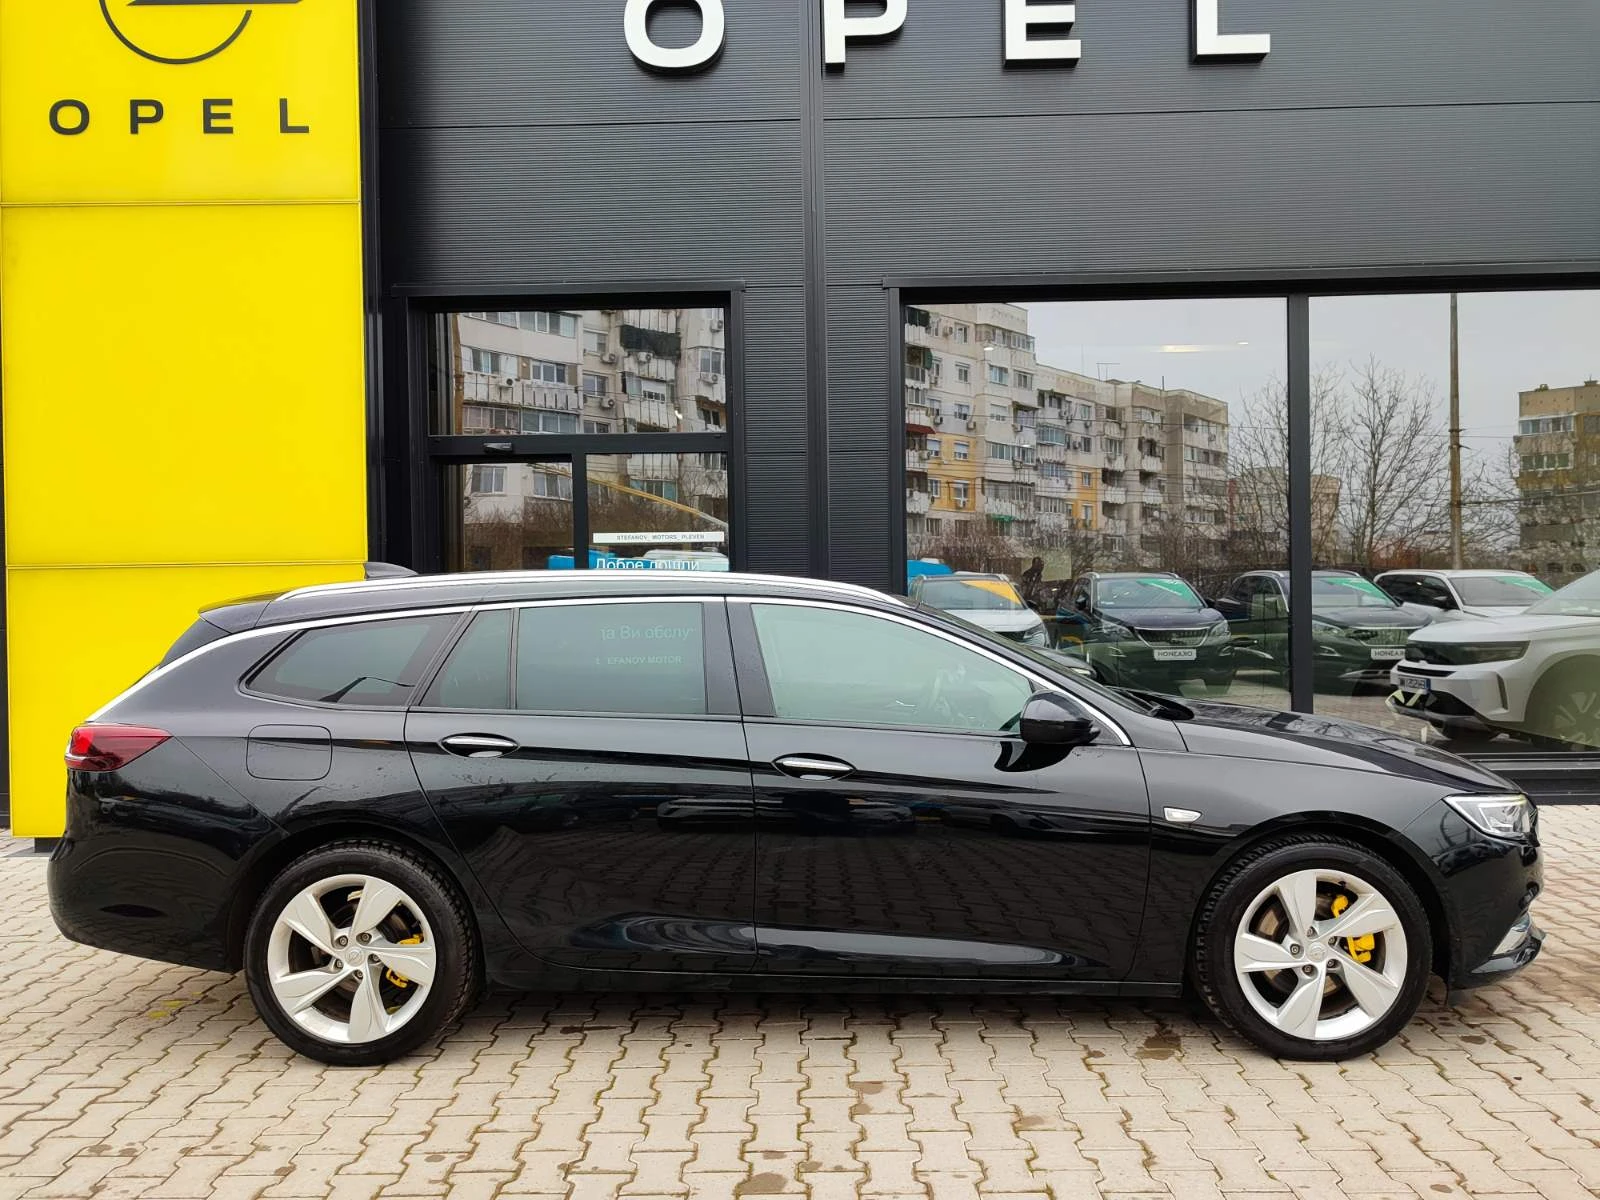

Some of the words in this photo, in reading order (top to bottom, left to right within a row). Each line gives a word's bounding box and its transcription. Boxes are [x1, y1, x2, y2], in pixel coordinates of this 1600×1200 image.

[623, 0, 1271, 69] OPEL
[49, 98, 309, 135] OPEL
[645, 624, 697, 641] обслу
